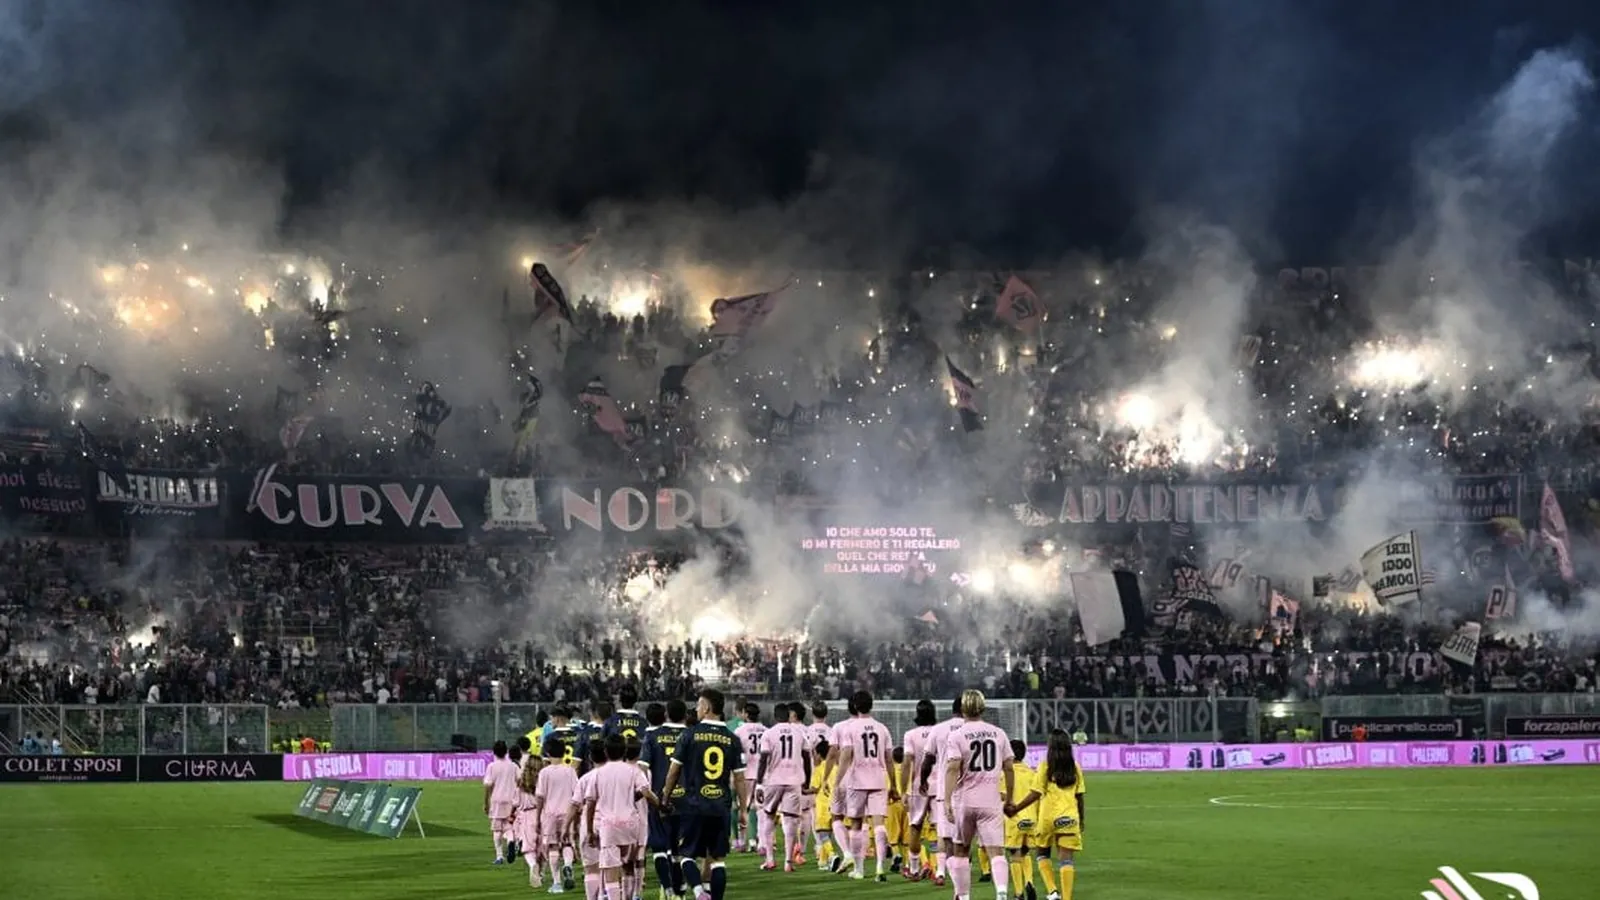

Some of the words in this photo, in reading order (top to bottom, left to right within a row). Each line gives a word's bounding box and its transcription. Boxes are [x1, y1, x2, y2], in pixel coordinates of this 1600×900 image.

[98, 470, 218, 503] DFFIDATI
[255, 481, 463, 528] CURVA
[562, 486, 742, 532] NORD
[1059, 483, 1326, 523] APPARTENENZA
[802, 539, 813, 549] IO
[815, 539, 828, 549] MI
[882, 539, 889, 549] E
[891, 539, 902, 549] TI
[826, 527, 838, 537] IO
[839, 527, 862, 537] CHE
[863, 527, 888, 537] AMO
[889, 527, 917, 537] SOLO
[836, 551, 866, 562] QUEL
[867, 551, 889, 561] CHE
[891, 551, 926, 561] RESA
[860, 563, 881, 573] MIA
[780, 735, 793, 759] 11
[861, 732, 879, 758] 13
[969, 740, 996, 772] 20
[5, 758, 69, 772] COLET
[73, 758, 122, 772] SPOSI
[165, 759, 256, 778] CIURMA
[302, 760, 312, 779] A
[315, 755, 362, 777] SCUOLA
[385, 759, 404, 777] CON
[439, 758, 486, 777] PALERMO
[704, 746, 724, 780] 9
